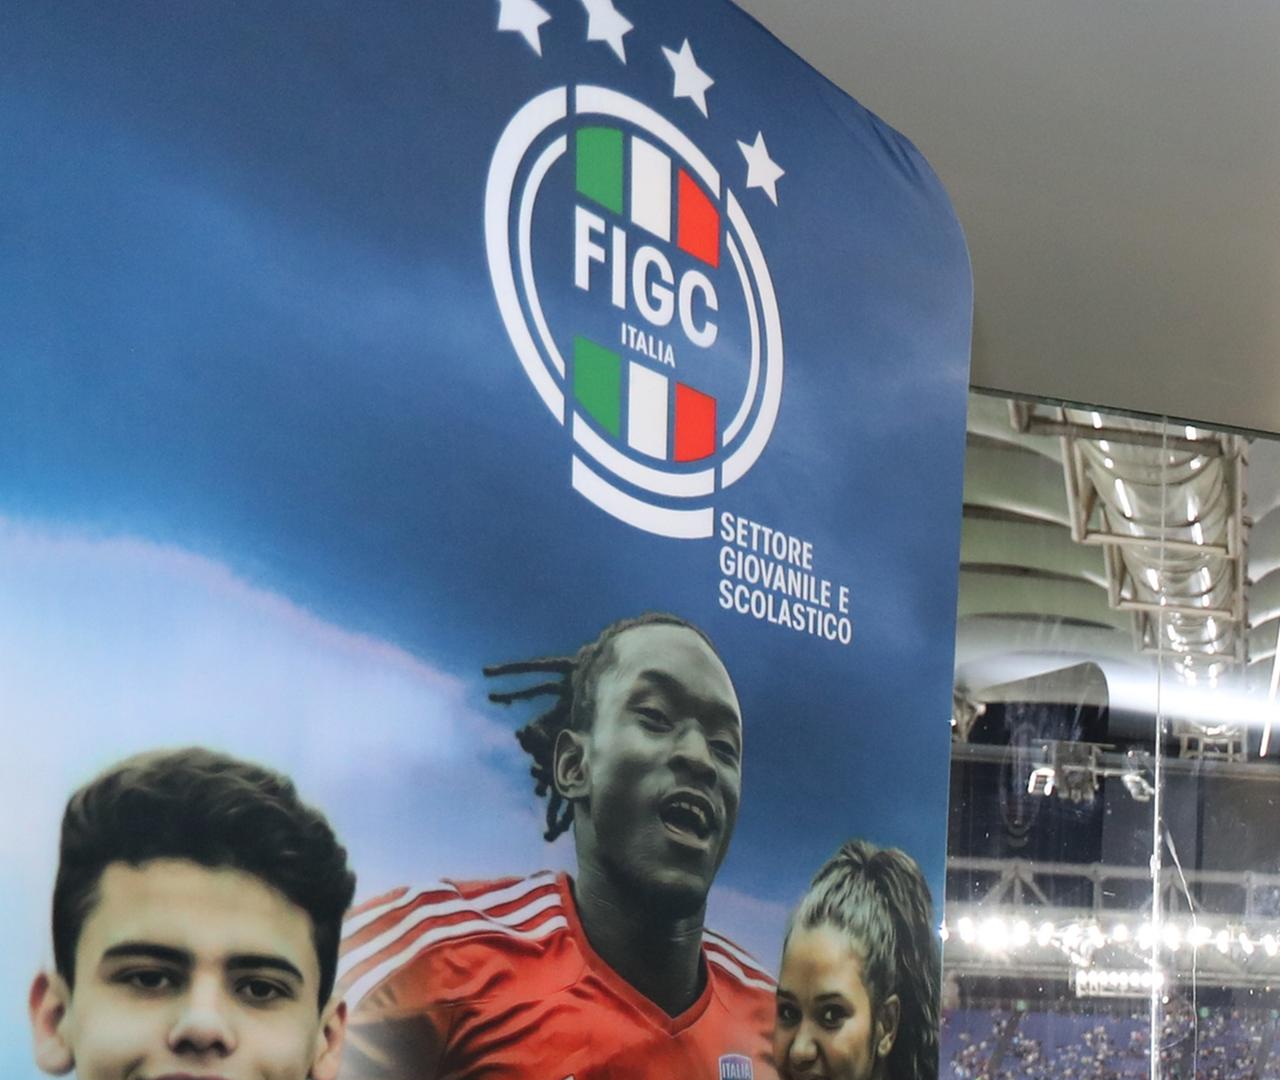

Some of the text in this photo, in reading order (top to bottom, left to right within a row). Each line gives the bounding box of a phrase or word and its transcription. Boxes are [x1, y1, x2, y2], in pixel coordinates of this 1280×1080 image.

[575, 205, 718, 348] FIGC
[622, 322, 676, 368] ITALIA
[720, 511, 813, 571] SETTORE
[719, 545, 850, 615] GIOVANILE E
[718, 579, 852, 645] SCOLASTICO
[721, 1062, 752, 1079] ITALIA
